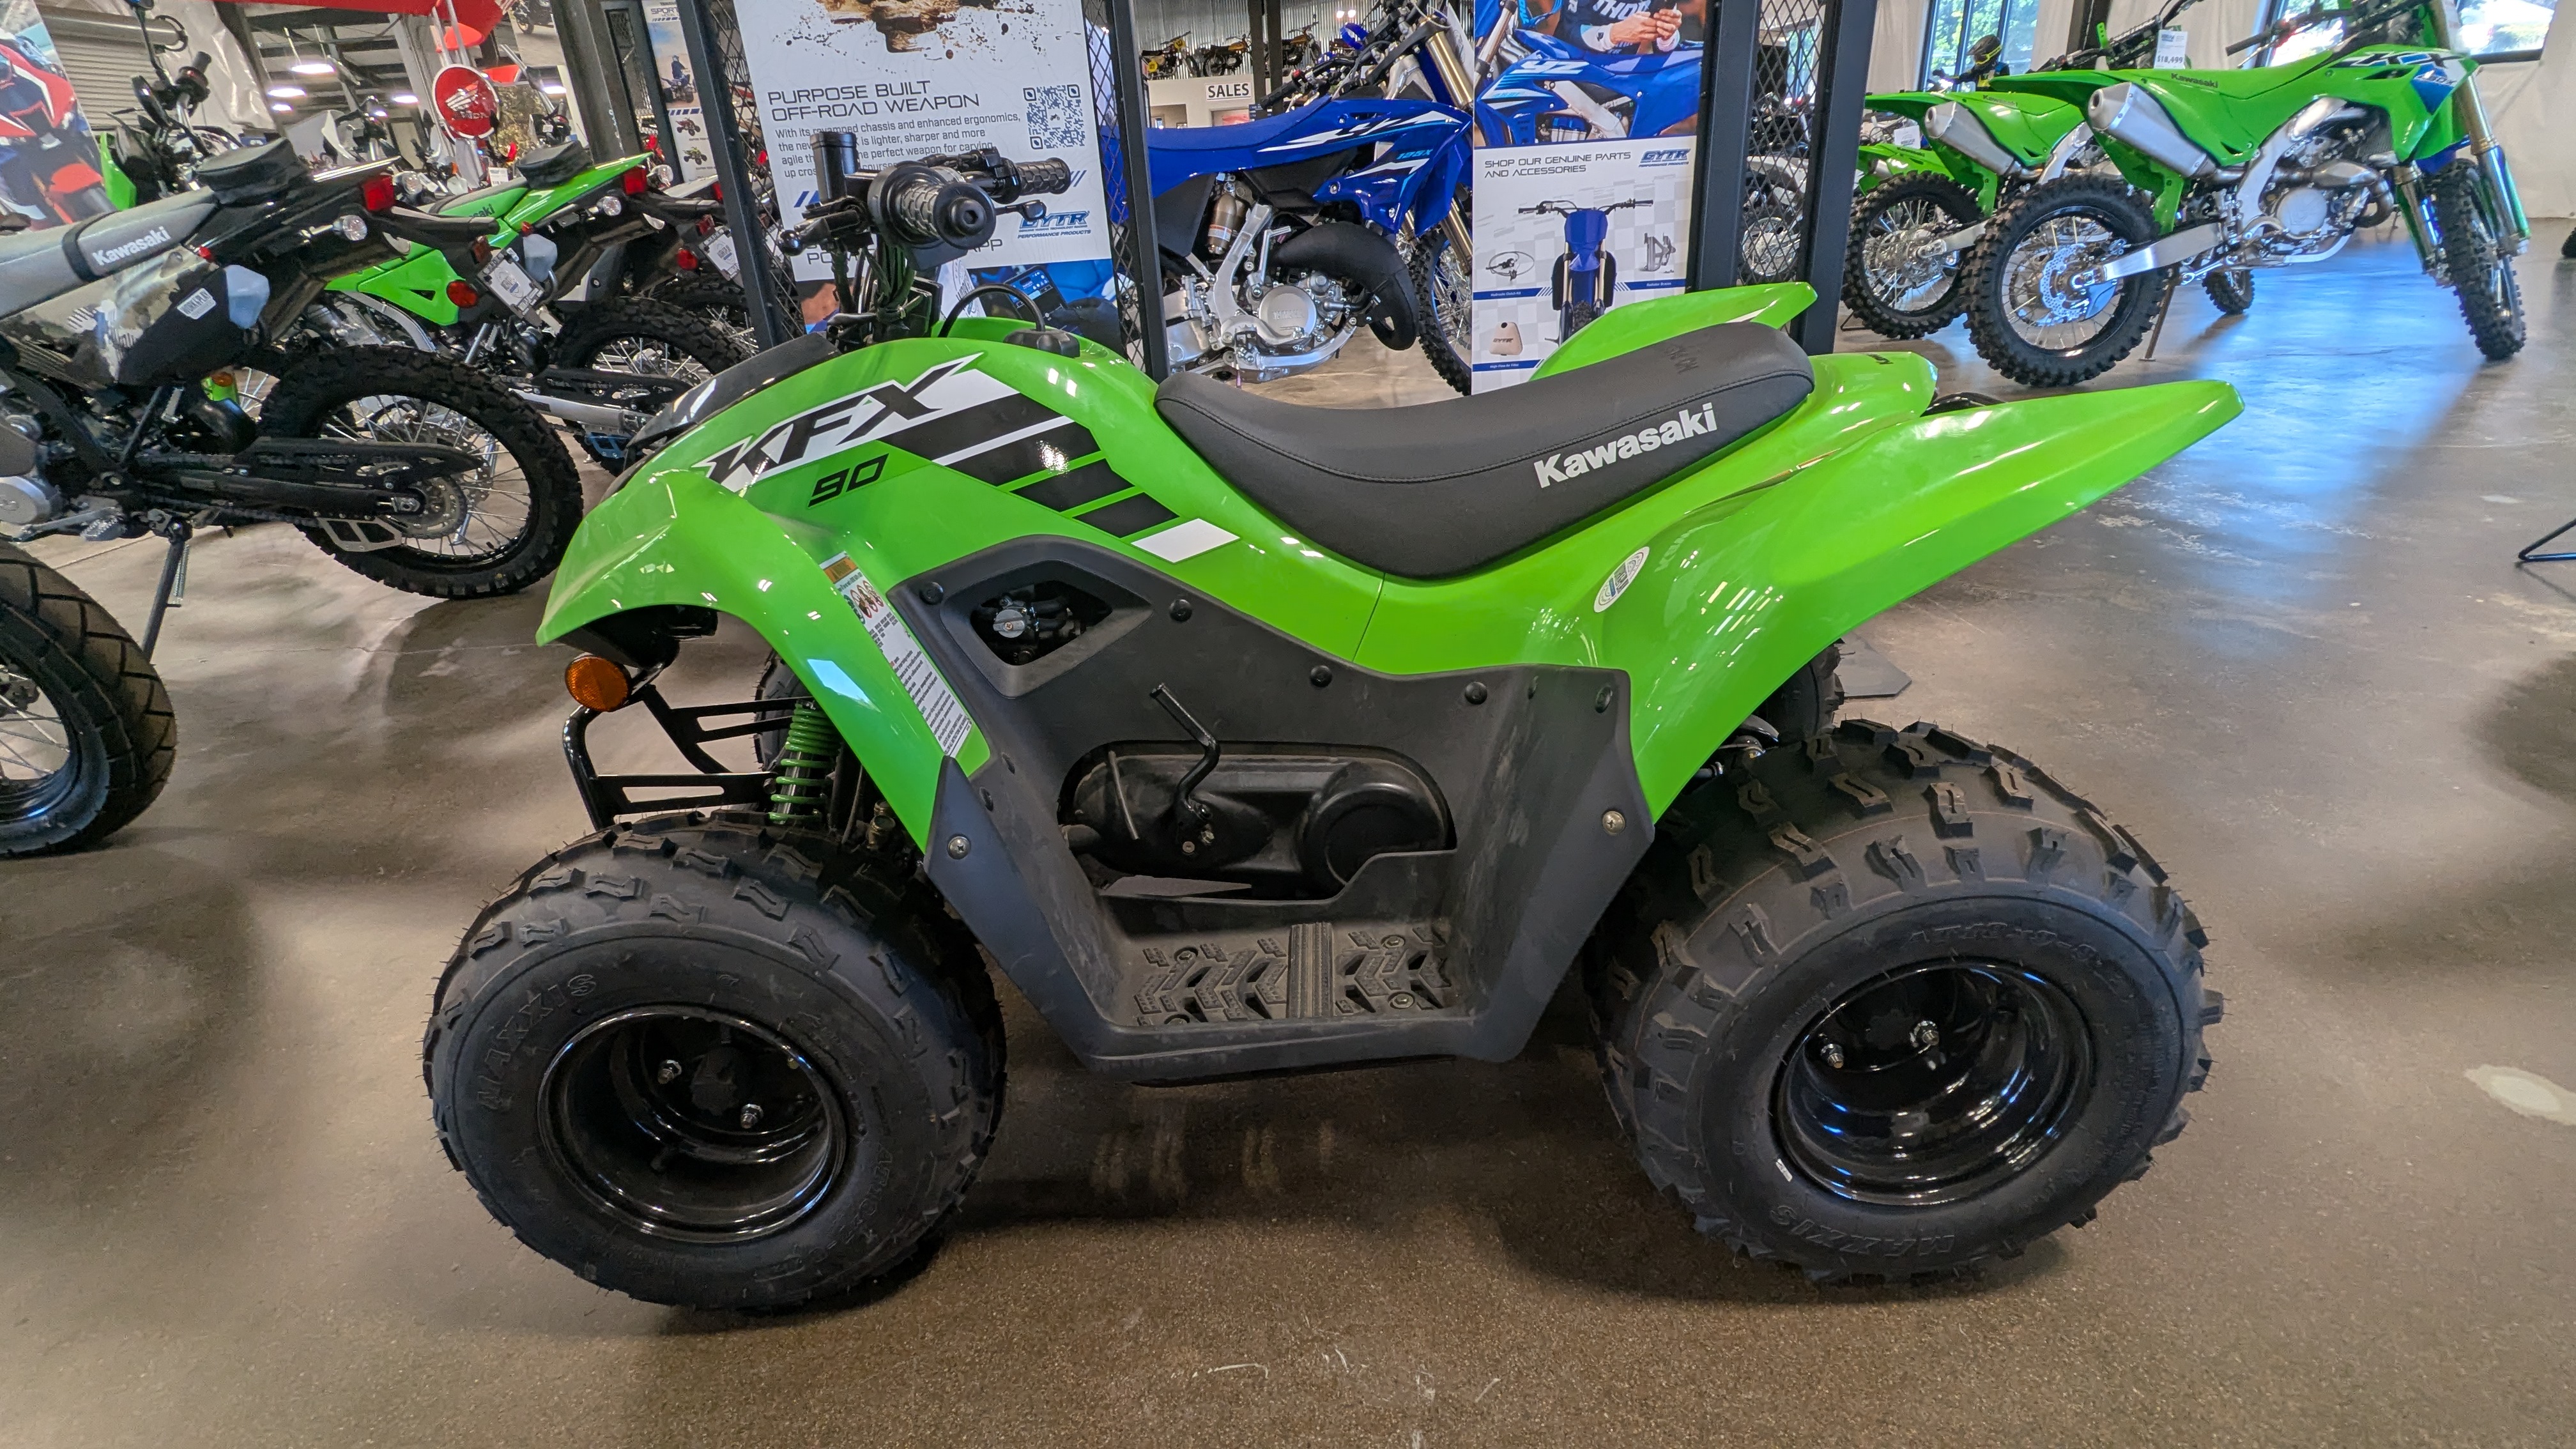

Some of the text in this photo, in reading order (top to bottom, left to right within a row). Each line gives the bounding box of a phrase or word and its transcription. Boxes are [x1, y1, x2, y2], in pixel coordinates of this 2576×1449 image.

[2171, 72, 2218, 88] Kawasaki
[767, 80, 931, 105] PURPOSE BUILT
[1208, 83, 1249, 98] SALES
[771, 93, 980, 121] OFF-ROAD WEAPON
[775, 128, 797, 139] With
[799, 128, 811, 137] its
[861, 121, 896, 132] chassis
[898, 119, 915, 130] and
[917, 116, 962, 128] enhanced
[964, 112, 1021, 126] ergonomics,
[861, 136, 870, 146] is
[871, 135, 903, 146] lighter,
[904, 132, 940, 142] sharper
[942, 129, 960, 139] and
[962, 129, 986, 138] more
[778, 142, 794, 152] the
[871, 148, 905, 160] perfect
[905, 146, 942, 156] weapon
[944, 143, 957, 153] for
[959, 141, 993, 151] carving
[1641, 148, 1690, 161] GYTR
[781, 155, 804, 166] agile
[1485, 151, 1631, 168] SHOP OUR GENUINE PARTS
[784, 169, 796, 179] up
[1485, 165, 1587, 178] AND ACCESSORIES
[92, 226, 171, 266] Kawasaki
[693, 353, 984, 492] KFX
[1534, 402, 1717, 488] Kawasaki
[808, 453, 889, 507] 90
